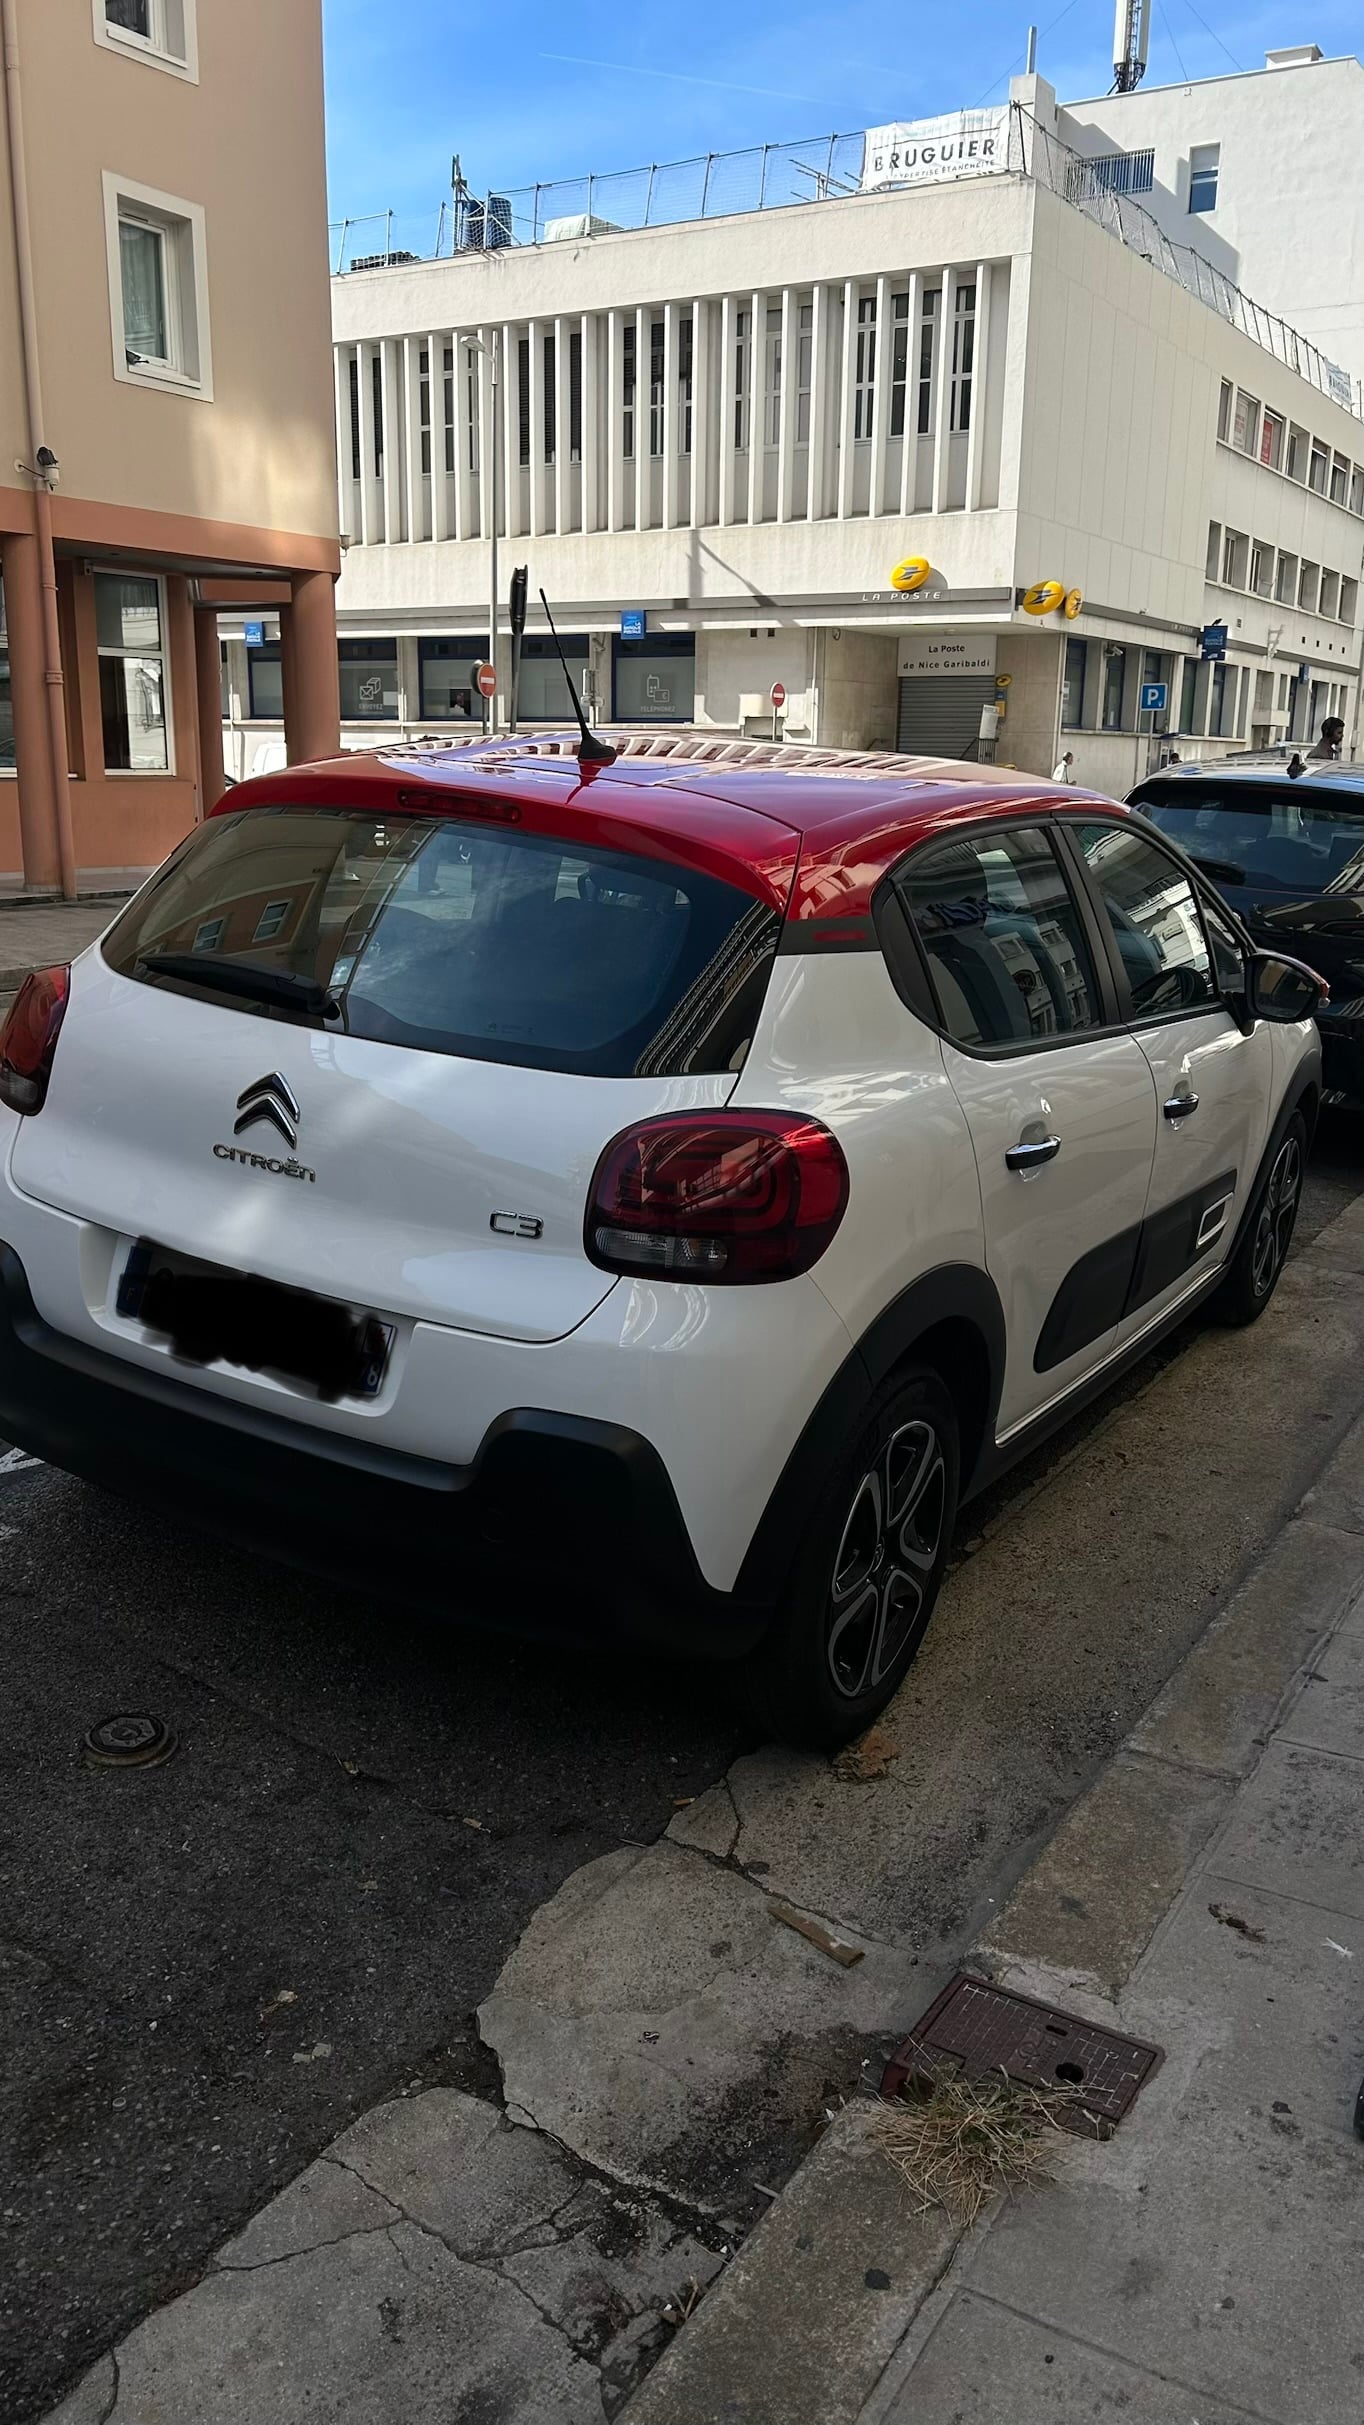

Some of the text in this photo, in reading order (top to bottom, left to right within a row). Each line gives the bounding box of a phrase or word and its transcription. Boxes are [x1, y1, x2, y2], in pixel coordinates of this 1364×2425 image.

[874, 139, 995, 172] BRUGUIER
[862, 591, 942, 602] LA POSTE
[928, 645, 965, 653] La Poste
[918, 661, 940, 669] Nice
[943, 659, 990, 668] Garibaldi
[1147, 689, 1159, 705] P
[213, 1144, 316, 1182] CITROËN
[490, 1209, 544, 1239] C3
